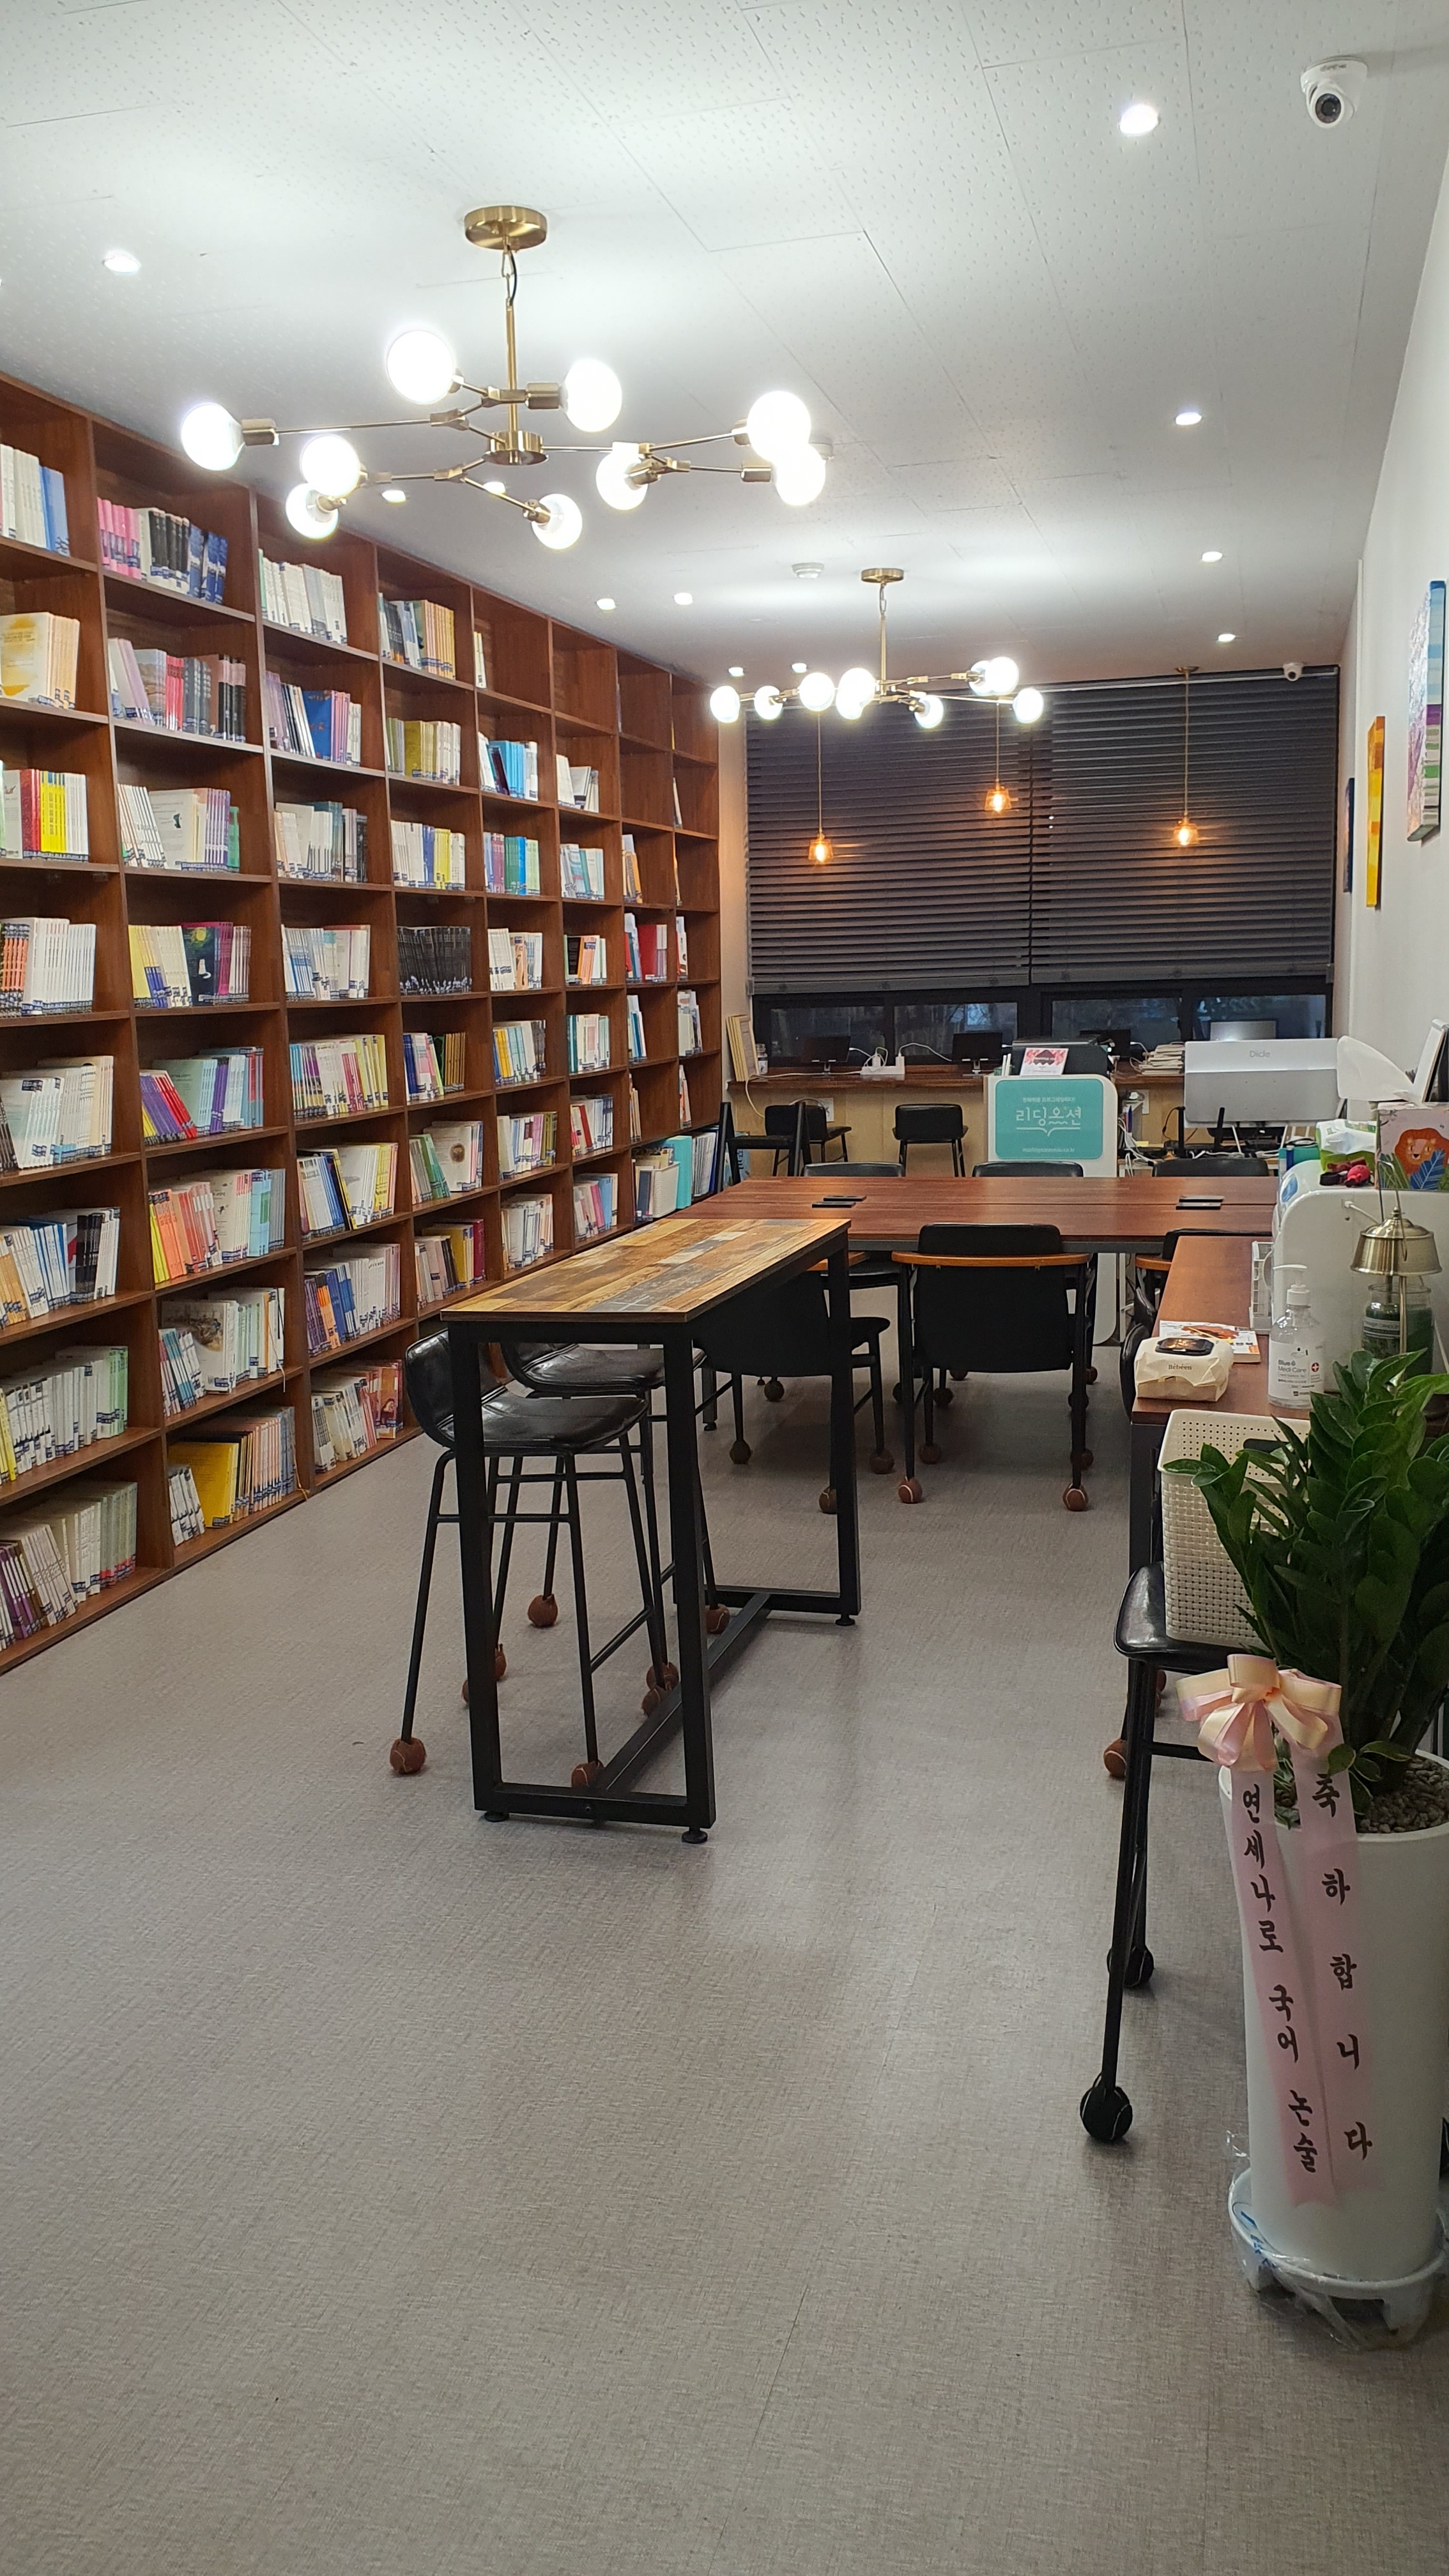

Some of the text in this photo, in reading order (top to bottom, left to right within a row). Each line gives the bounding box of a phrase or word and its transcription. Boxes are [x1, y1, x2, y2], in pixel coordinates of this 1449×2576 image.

[1243, 1783, 1318, 2174] 연세나로 국어 논술
[1312, 1773, 1373, 2161] 축하합니다
